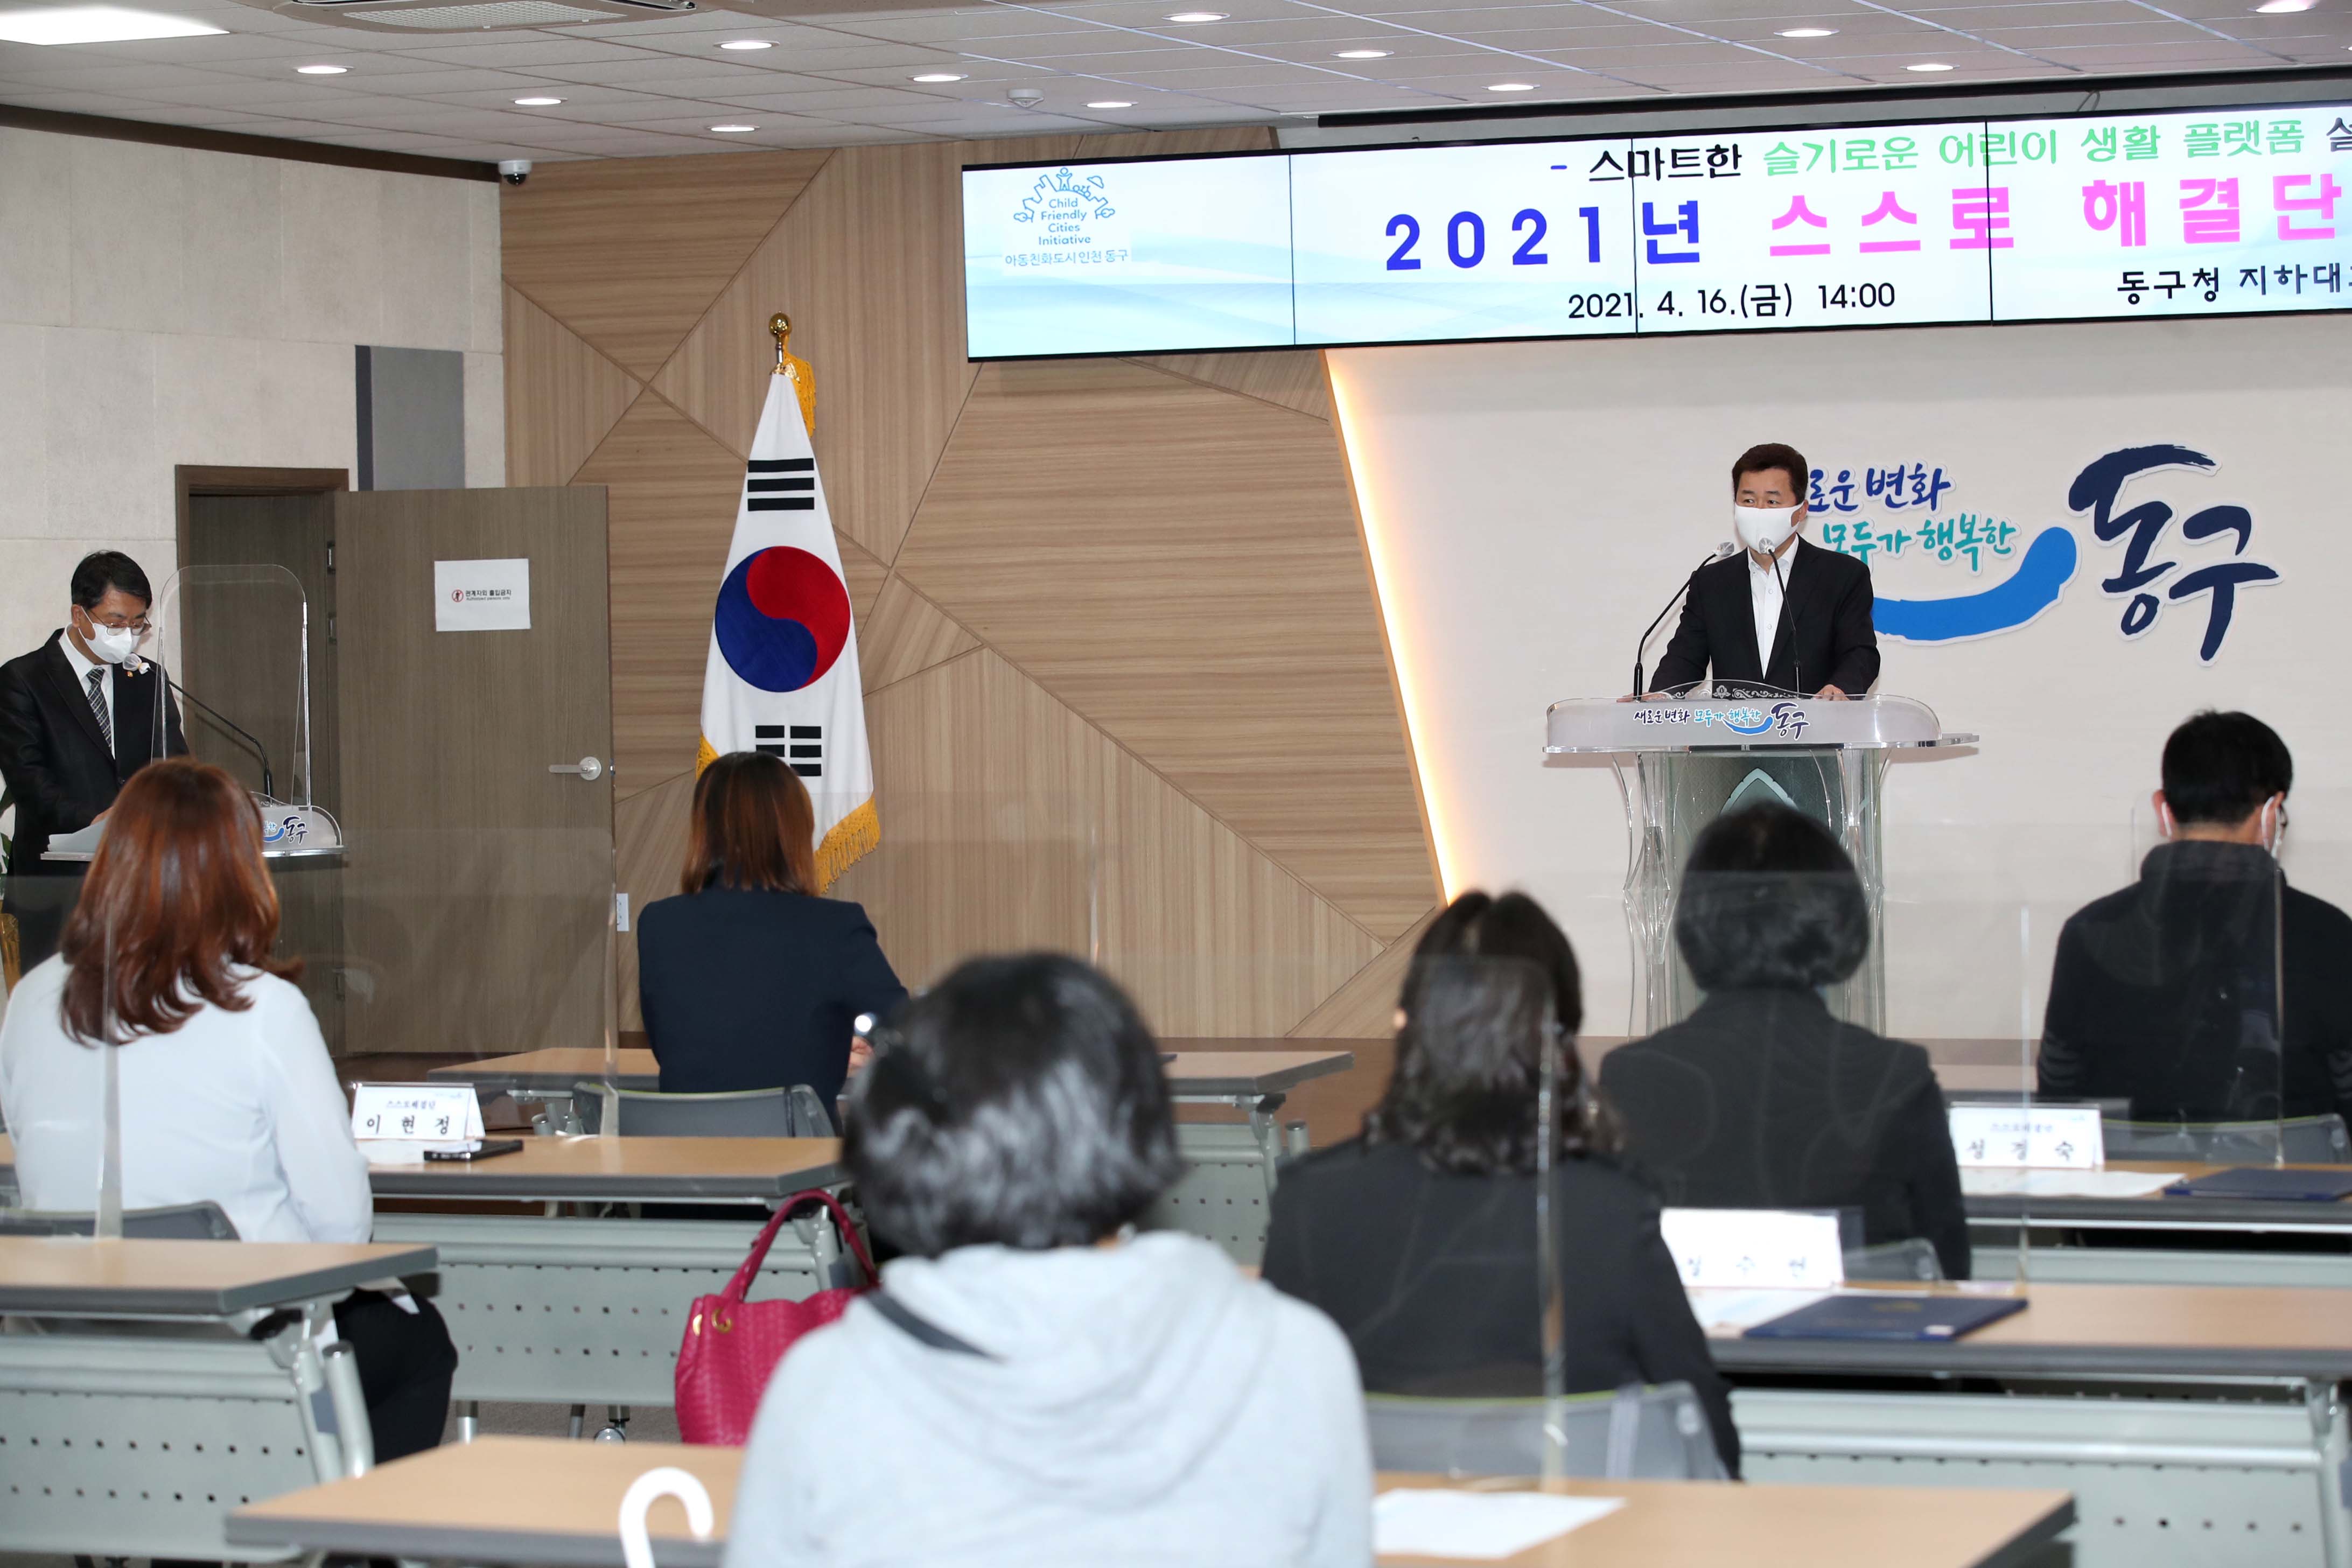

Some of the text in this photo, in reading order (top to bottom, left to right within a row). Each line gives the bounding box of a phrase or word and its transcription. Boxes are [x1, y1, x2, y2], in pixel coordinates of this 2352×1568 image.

[1588, 143, 1742, 181] 스마트한
[1763, 137, 1919, 177] 슬기로운
[1939, 129, 2057, 167] 어린이
[2081, 124, 2161, 163] 생활
[2183, 120, 2305, 158] 플랫폼
[1040, 209, 1087, 221] Friendly
[1048, 197, 1079, 209] Child
[1385, 173, 2342, 271] 2021년 스스로 해결단
[1038, 234, 1091, 246] Initiative
[1048, 222, 1081, 233] Cities
[1569, 292, 1644, 319] 2021.
[1657, 291, 1683, 317] 4.
[1818, 282, 1895, 309] 14:00
[2117, 262, 2352, 305] 동구청 지하대
[1808, 463, 1951, 512] 로운 변화
[1823, 513, 2016, 572] 모두가 행복한
[2069, 444, 2280, 662] 동구
[1634, 702, 1809, 740] 새로운 변화 모두가 행복한 동구
[283, 816, 308, 844] 동구
